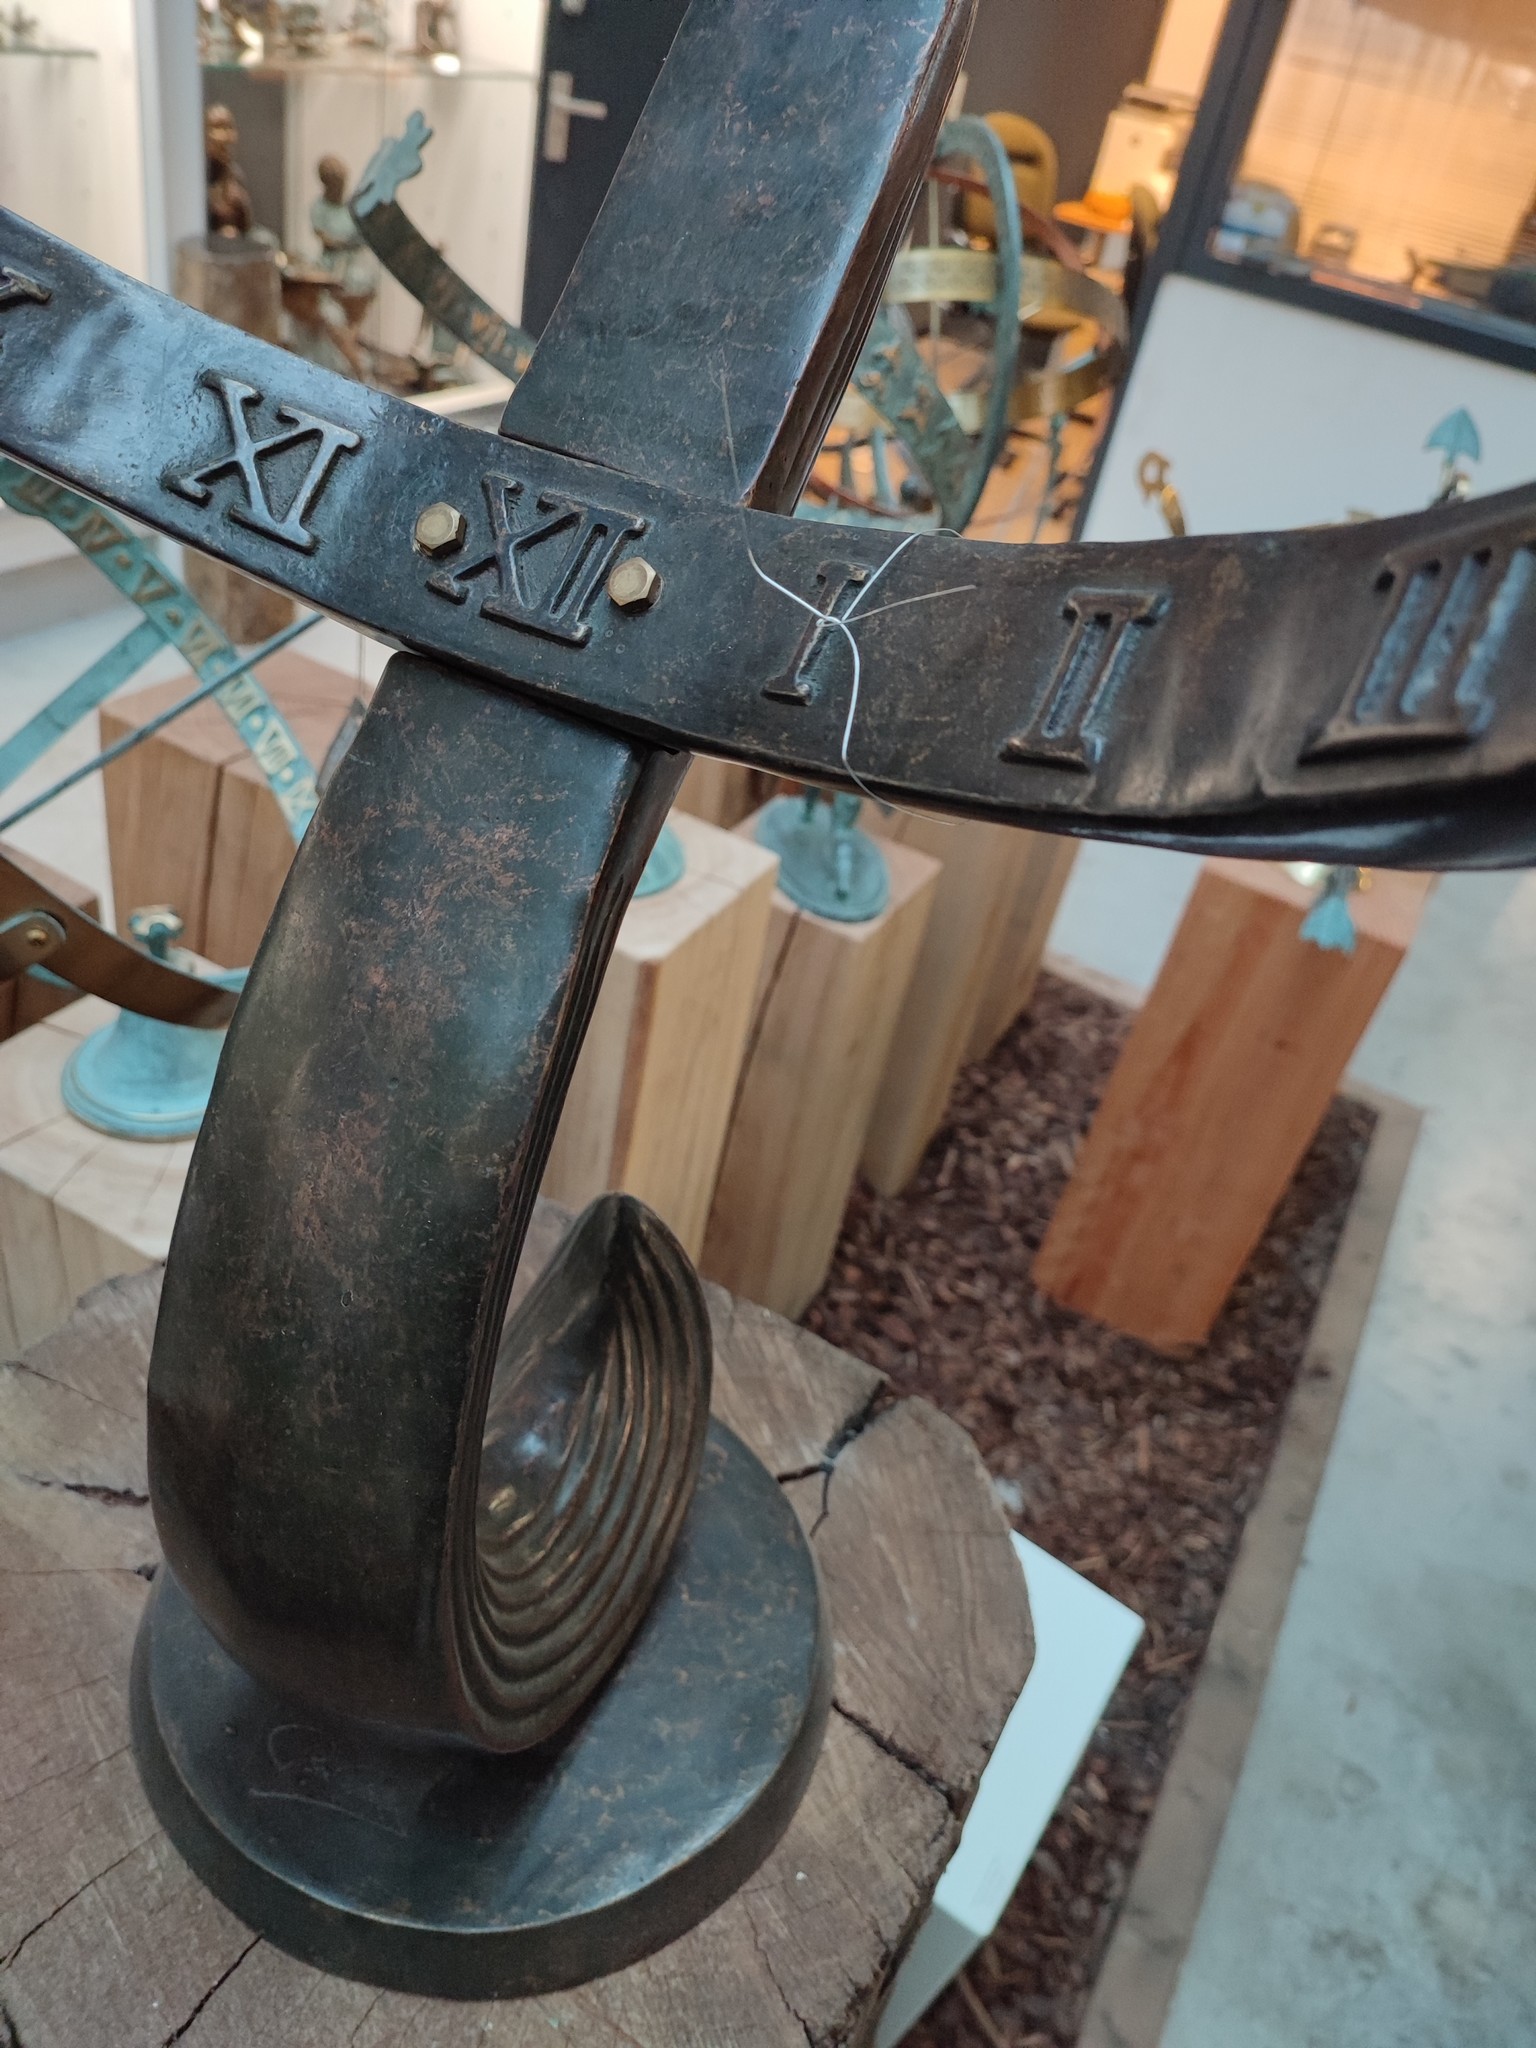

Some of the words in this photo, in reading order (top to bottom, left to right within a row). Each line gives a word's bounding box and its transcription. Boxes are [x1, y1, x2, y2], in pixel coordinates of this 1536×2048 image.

[163, 367, 362, 554] XI
[425, 470, 648, 649] XII
[761, 560, 872, 707] I
[999, 588, 1170, 771] II
